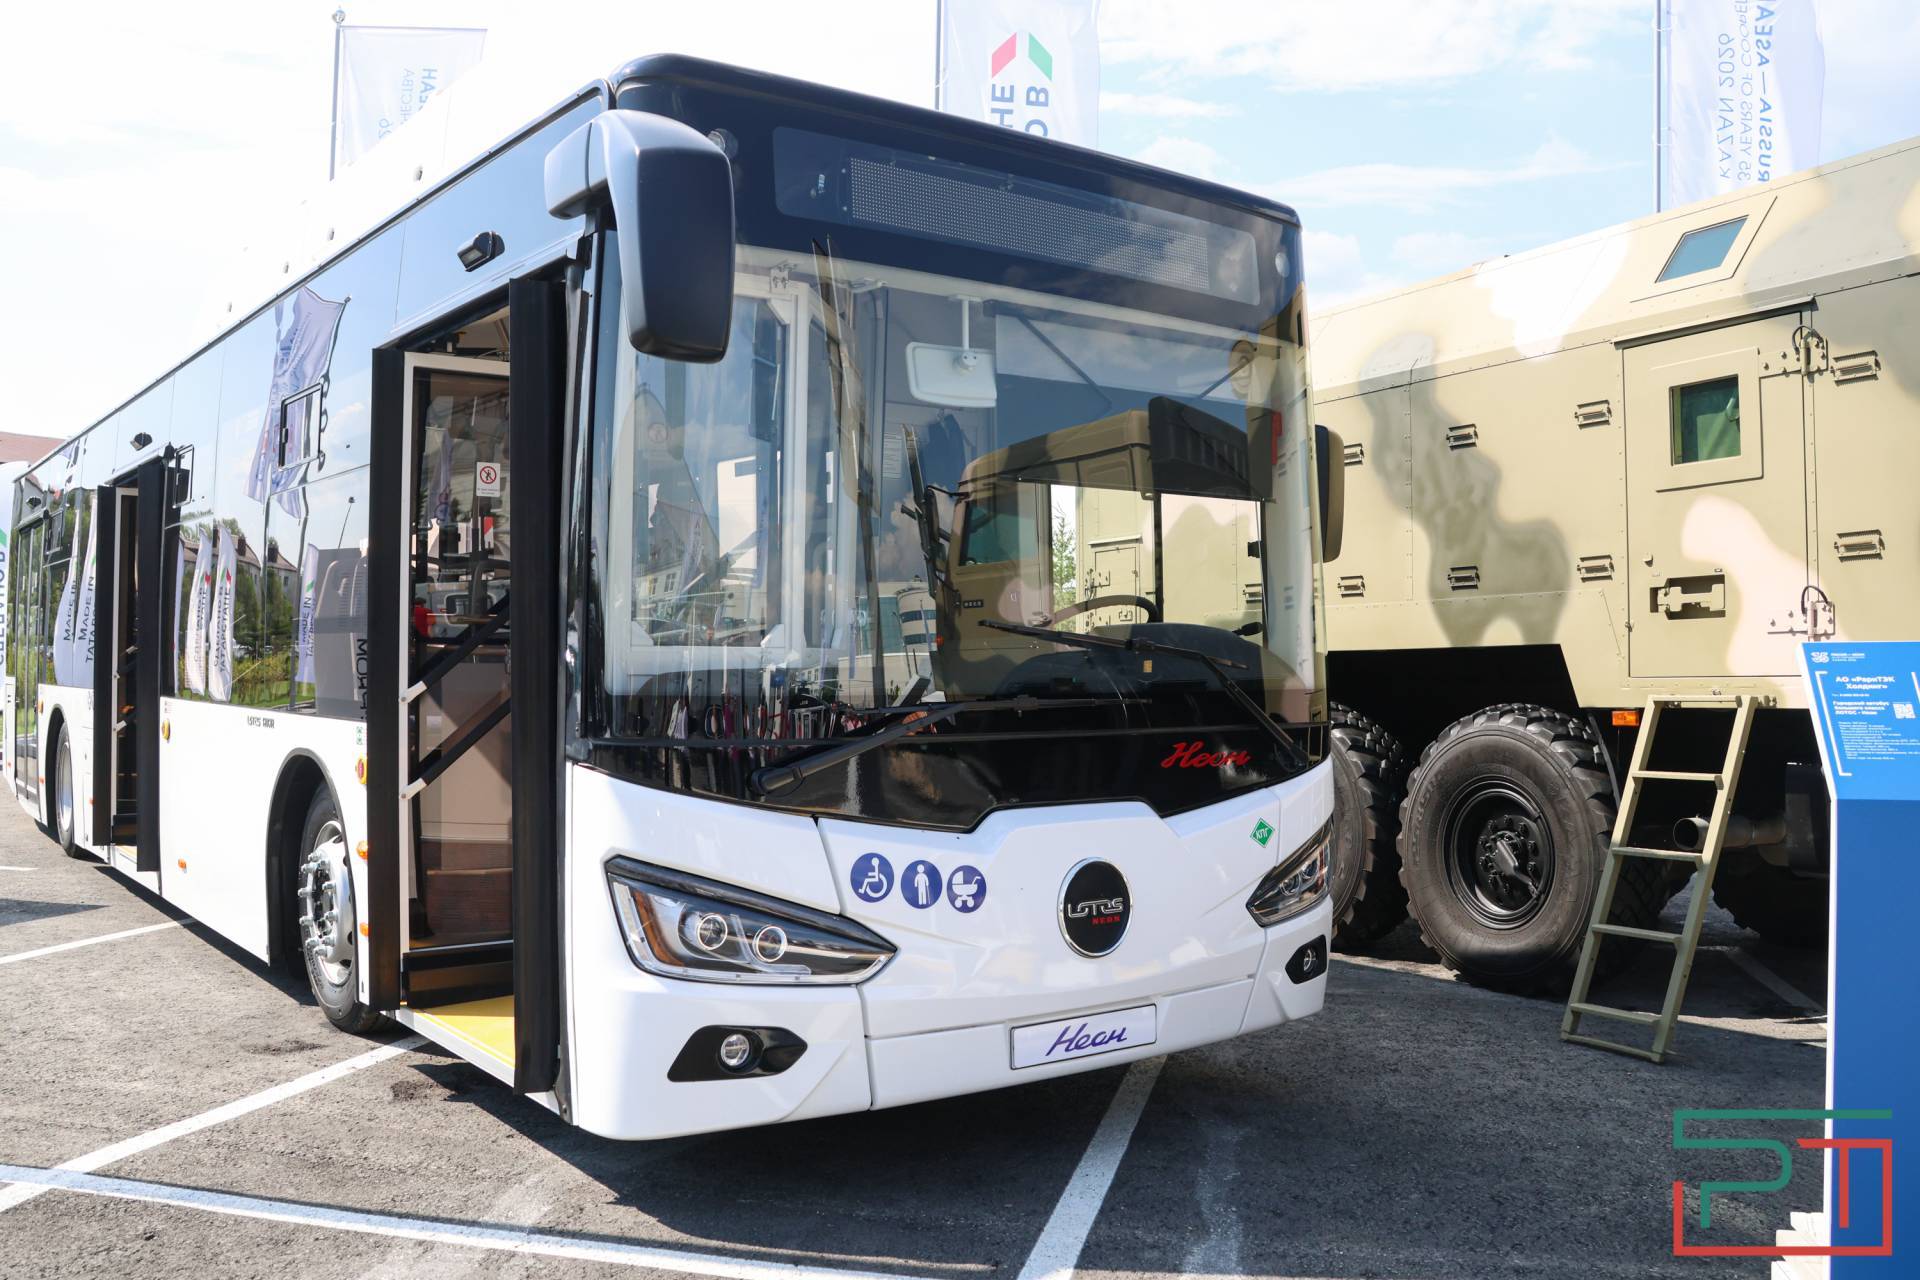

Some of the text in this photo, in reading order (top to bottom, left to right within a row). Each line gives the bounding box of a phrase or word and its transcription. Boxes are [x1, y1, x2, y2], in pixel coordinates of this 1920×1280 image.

[78, 597, 92, 640] MADE
[1160, 741, 1249, 768] Неон
[1045, 1022, 1127, 1056] Неон
